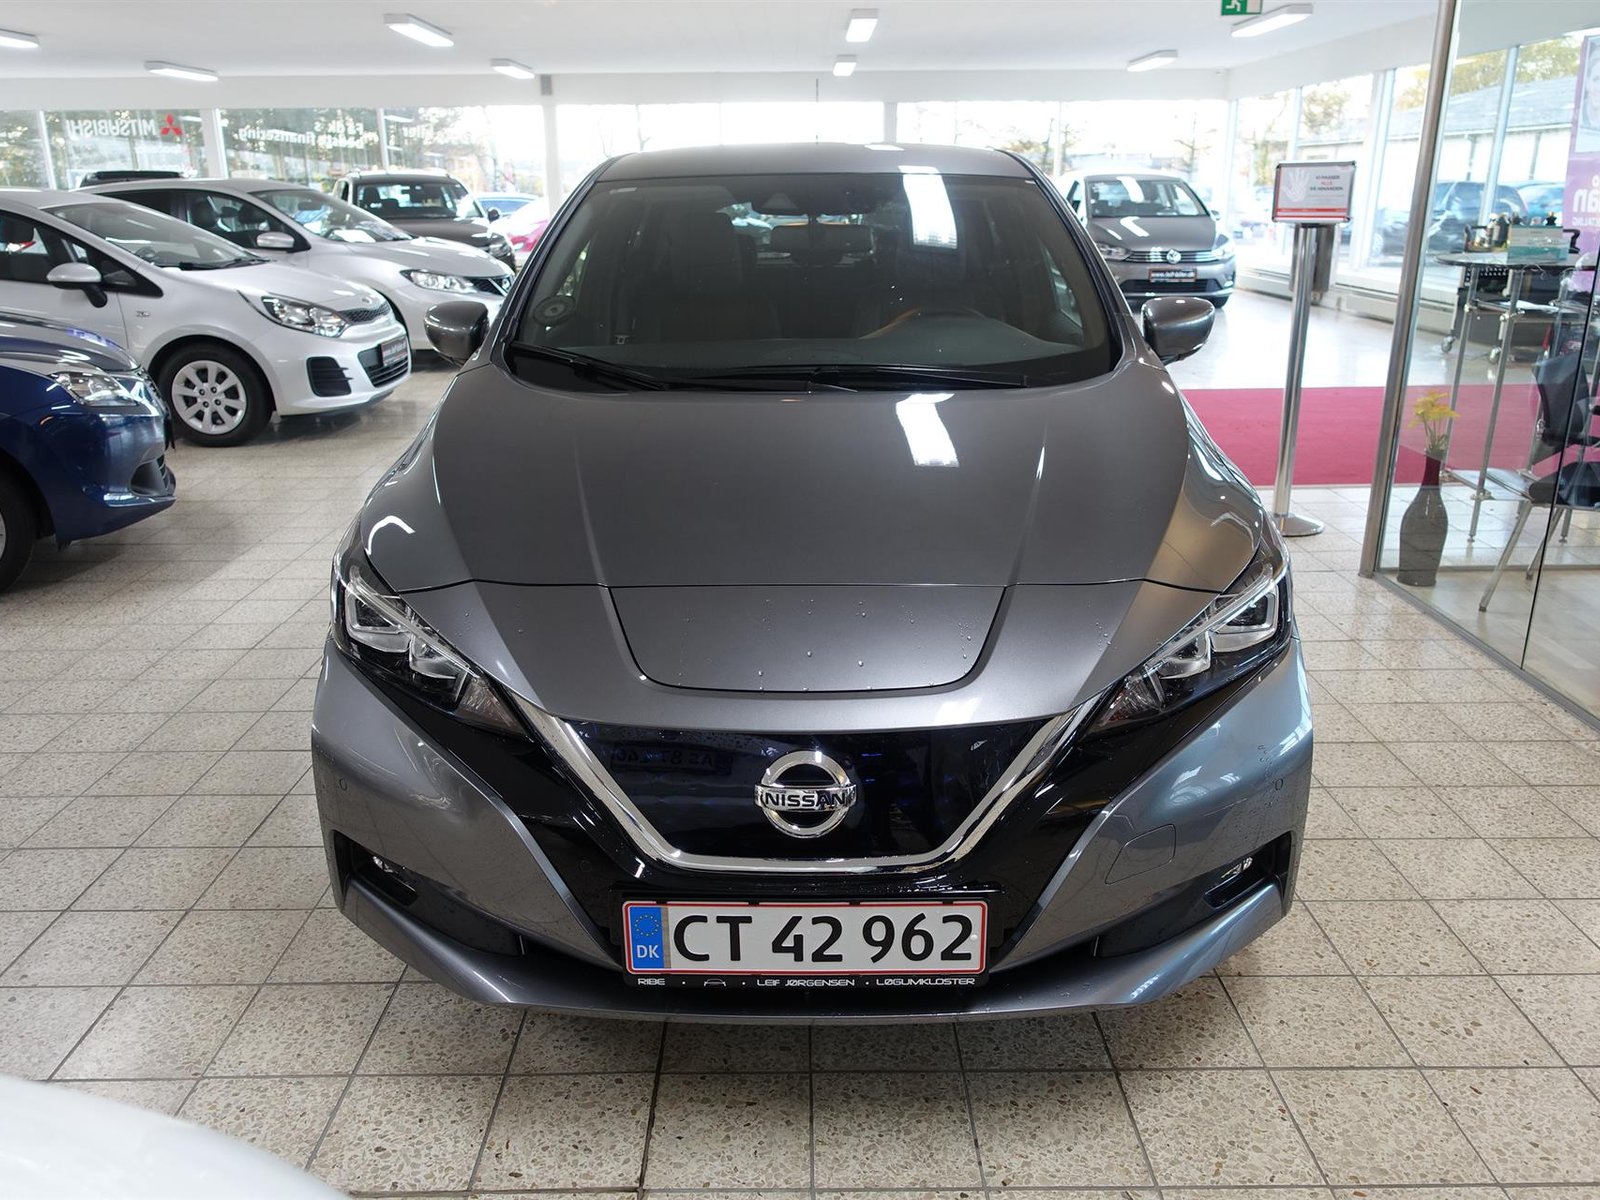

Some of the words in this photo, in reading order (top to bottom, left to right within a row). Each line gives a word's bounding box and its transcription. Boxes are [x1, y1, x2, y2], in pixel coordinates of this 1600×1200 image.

[765, 792, 847, 808] NISSAN
[673, 915, 753, 962] CT
[771, 915, 843, 963] 42
[862, 912, 973, 963] 962
[636, 945, 660, 959] DK
[637, 977, 666, 986] RIBE
[756, 979, 781, 987] LEIF
[784, 978, 856, 988] JØRGENSEN
[876, 976, 976, 986] LØGUMKLOSTER
